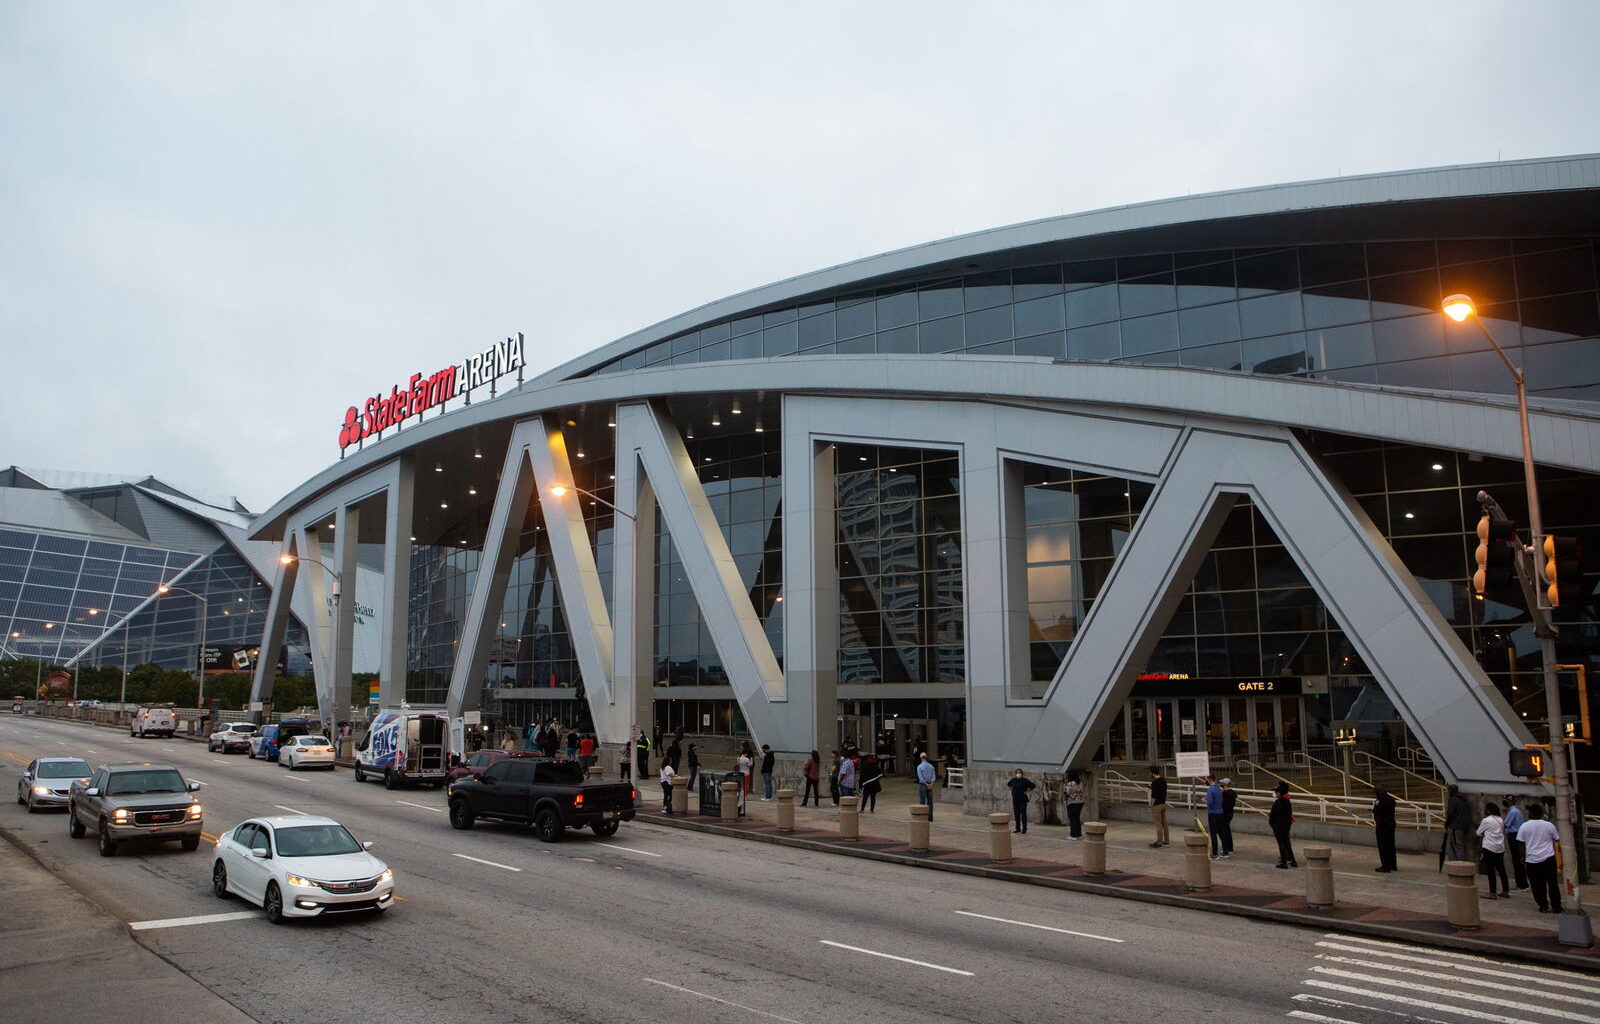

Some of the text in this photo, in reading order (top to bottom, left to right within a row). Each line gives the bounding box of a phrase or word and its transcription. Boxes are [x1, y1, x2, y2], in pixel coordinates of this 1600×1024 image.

[454, 332, 524, 397] ARENA
[1238, 682, 1274, 691] GATE 2
[1531, 755, 1541, 772] 4
